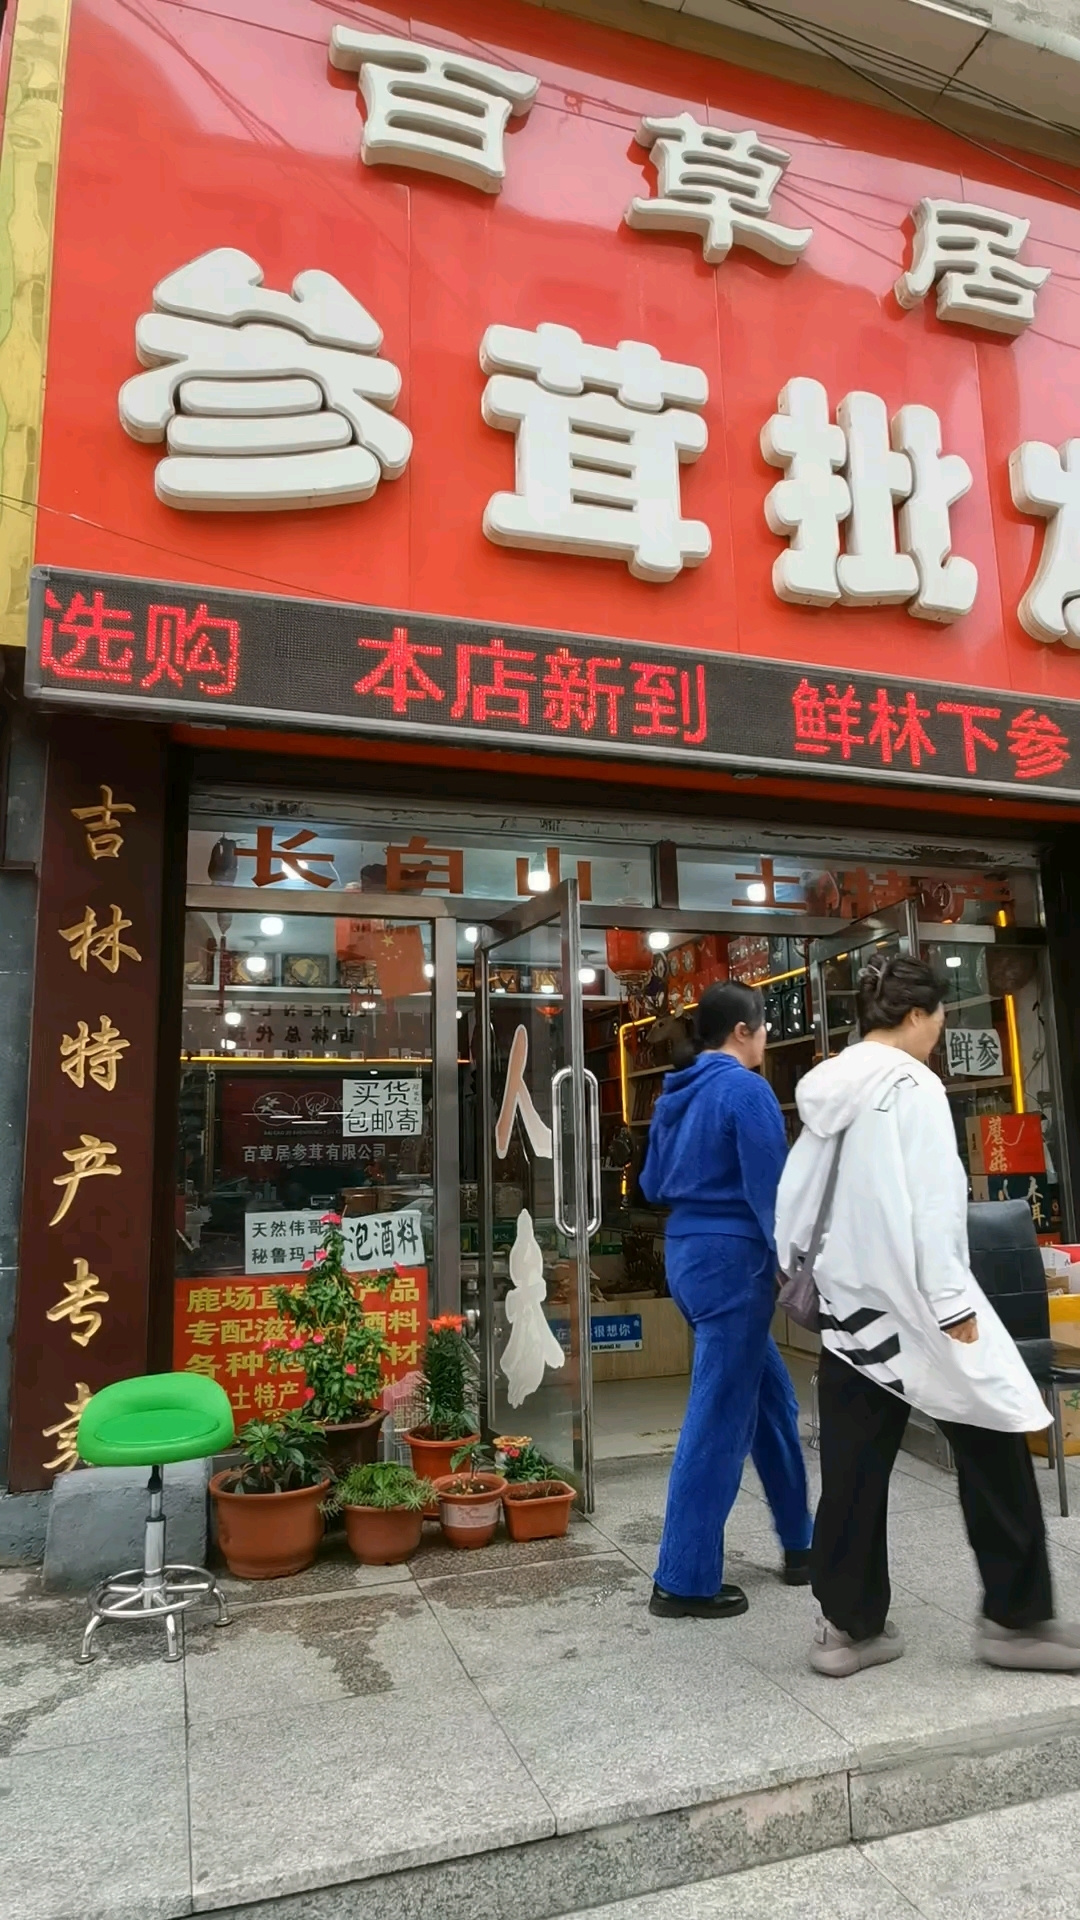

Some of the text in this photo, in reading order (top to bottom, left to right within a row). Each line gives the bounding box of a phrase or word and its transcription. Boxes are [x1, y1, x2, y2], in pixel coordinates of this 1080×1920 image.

[328, 24, 1052, 336] 百草居
[41, 589, 1070, 778] 选购 本店新到 鲜林下参
[234, 826, 592, 901] 长白山
[949, 1031, 999, 1072] 鲜参
[352, 1081, 411, 1107] 买货
[345, 1108, 419, 1134] 包邮寄
[350, 1217, 419, 1261] 泡酒料
